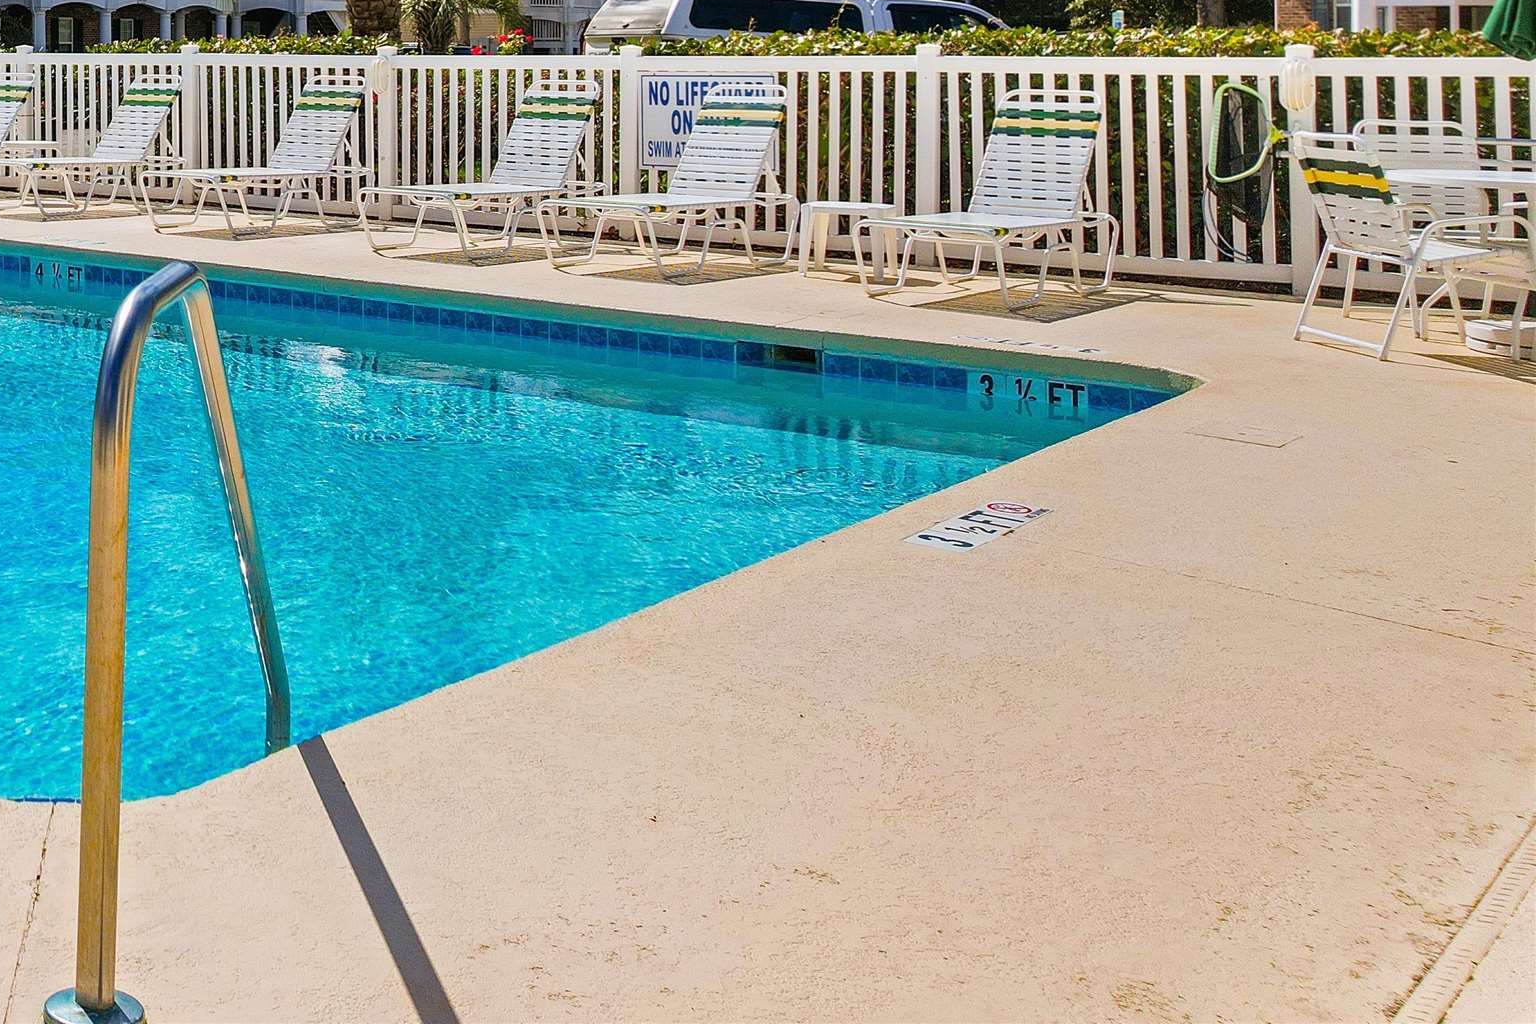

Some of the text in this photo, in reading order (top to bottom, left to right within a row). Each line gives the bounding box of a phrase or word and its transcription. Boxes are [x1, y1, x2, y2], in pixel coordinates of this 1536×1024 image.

[648, 80, 670, 106] NO
[671, 109, 693, 135] ON
[647, 140, 673, 158] SWIM
[674, 141, 687, 158] AT
[35, 262, 44, 276] 4
[67, 265, 83, 281] FT
[979, 374, 994, 396] 3
[1048, 381, 1085, 408] FT
[917, 533, 975, 548] 3
[958, 510, 1025, 529] FT
